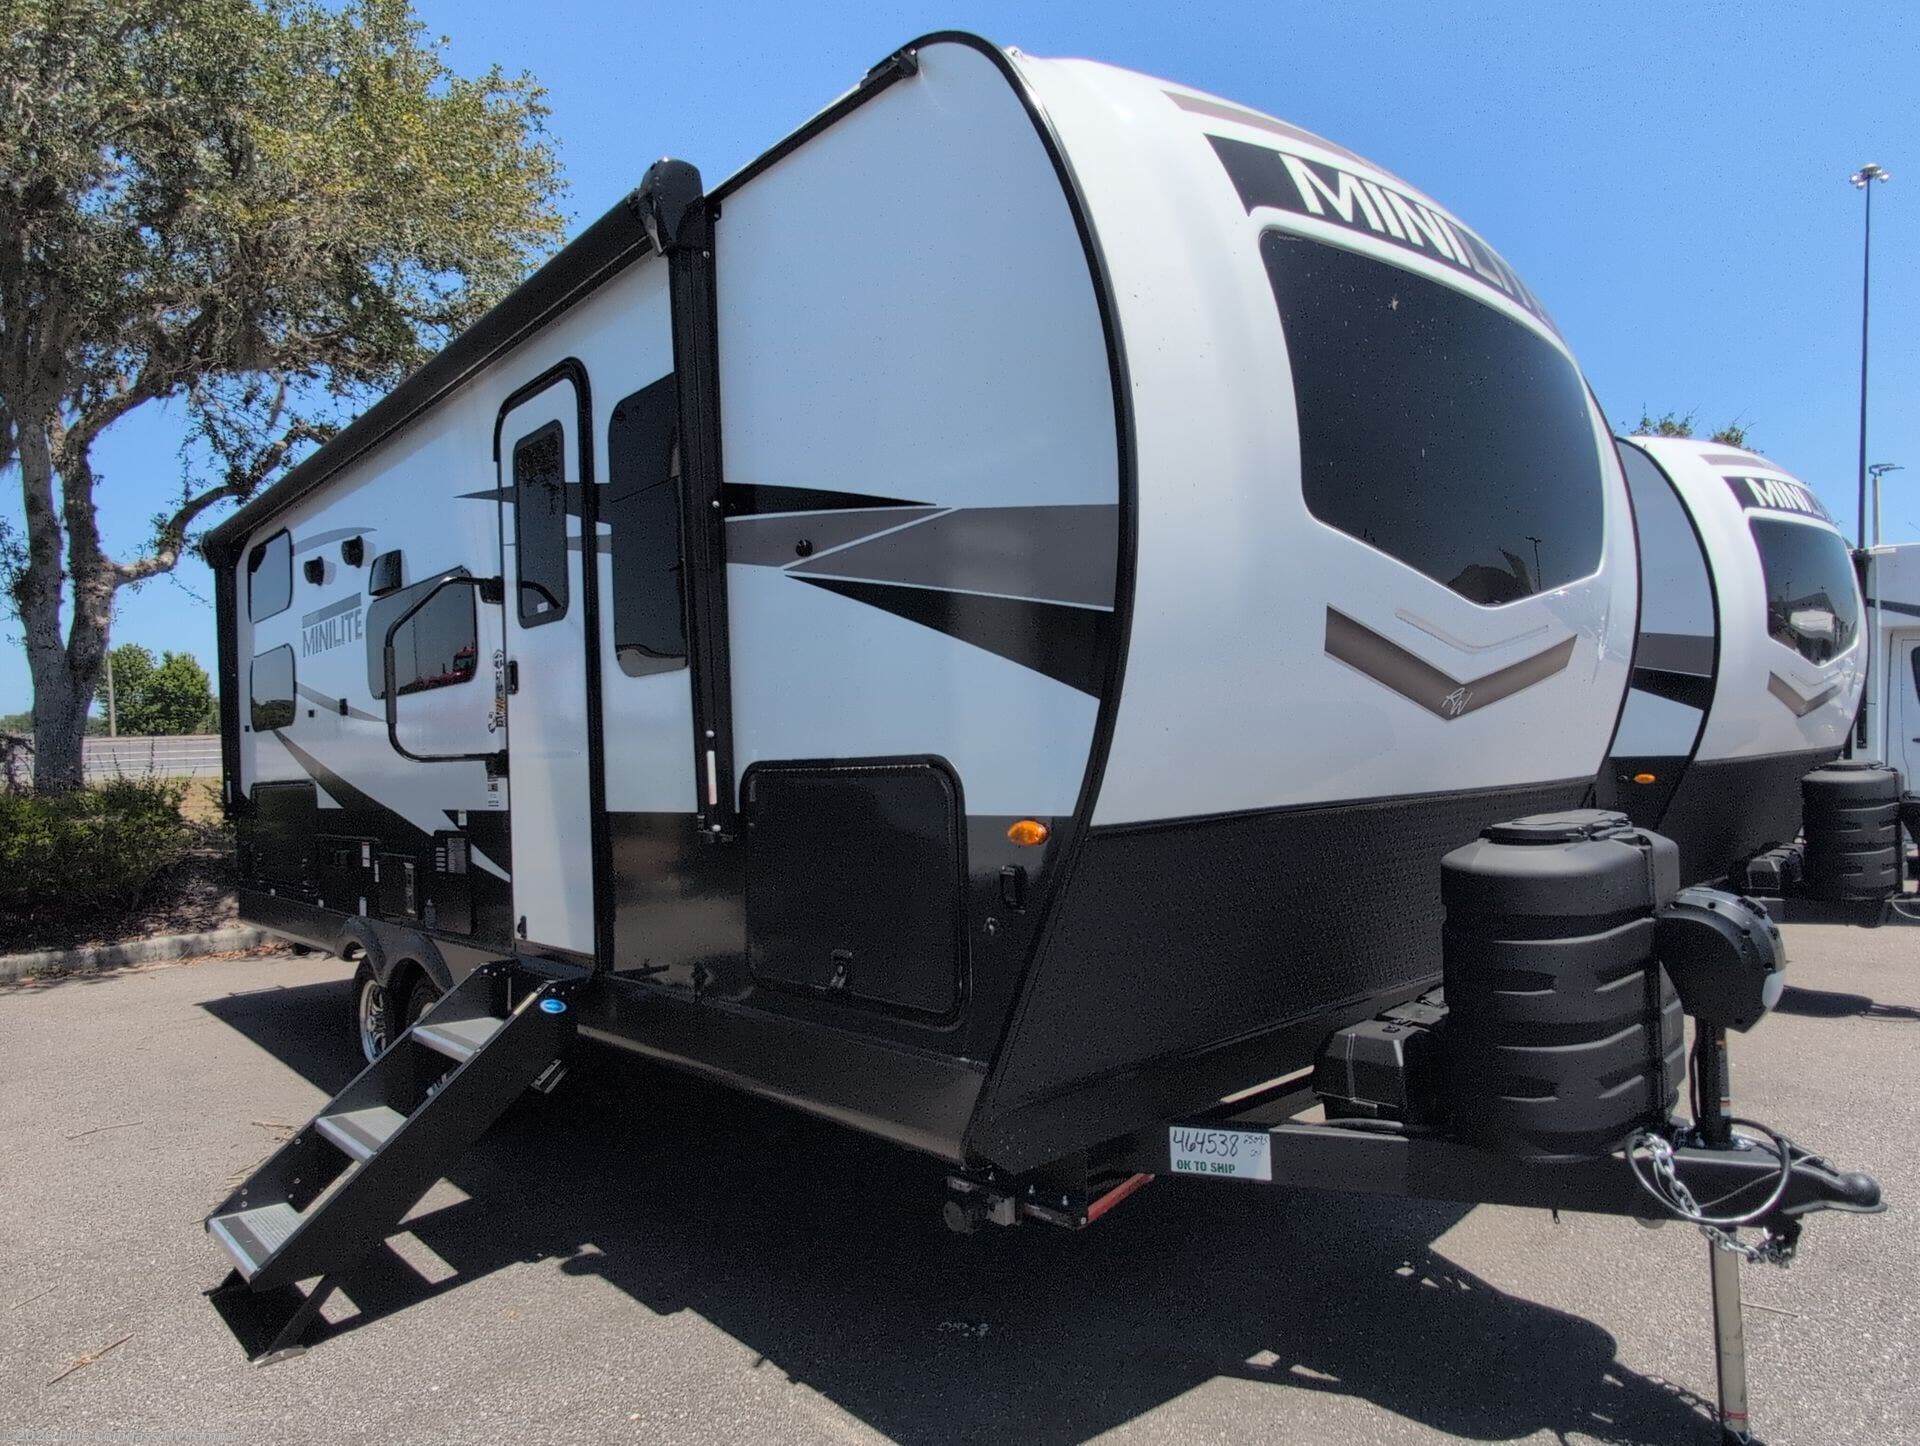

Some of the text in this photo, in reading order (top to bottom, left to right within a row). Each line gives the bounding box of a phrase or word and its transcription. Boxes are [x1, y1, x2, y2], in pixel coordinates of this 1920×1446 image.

[302, 608, 362, 658] MINILITE
[1173, 1129, 1239, 1157] 464538
[1176, 1159, 1236, 1174] OK TO SHIP
